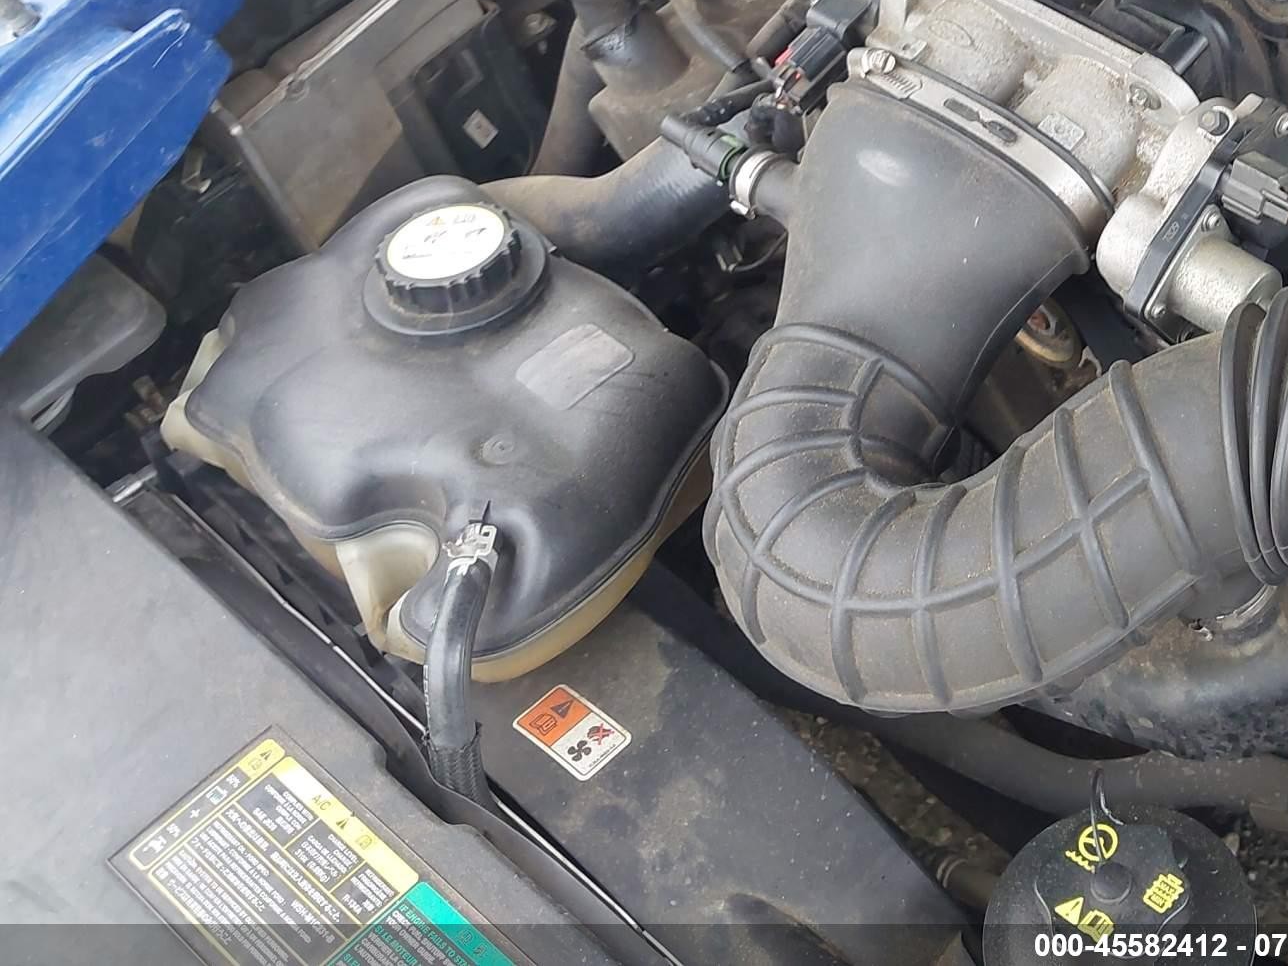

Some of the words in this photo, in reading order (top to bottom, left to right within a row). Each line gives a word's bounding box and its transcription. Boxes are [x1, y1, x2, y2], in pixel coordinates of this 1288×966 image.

[311, 793, 332, 811] A/C
[341, 894, 364, 914] R-134A
[384, 916, 402, 932] YOUR
[405, 910, 431, 934] ENGINE
[427, 931, 447, 949] FAILS
[390, 940, 418, 966] MOTEUR
